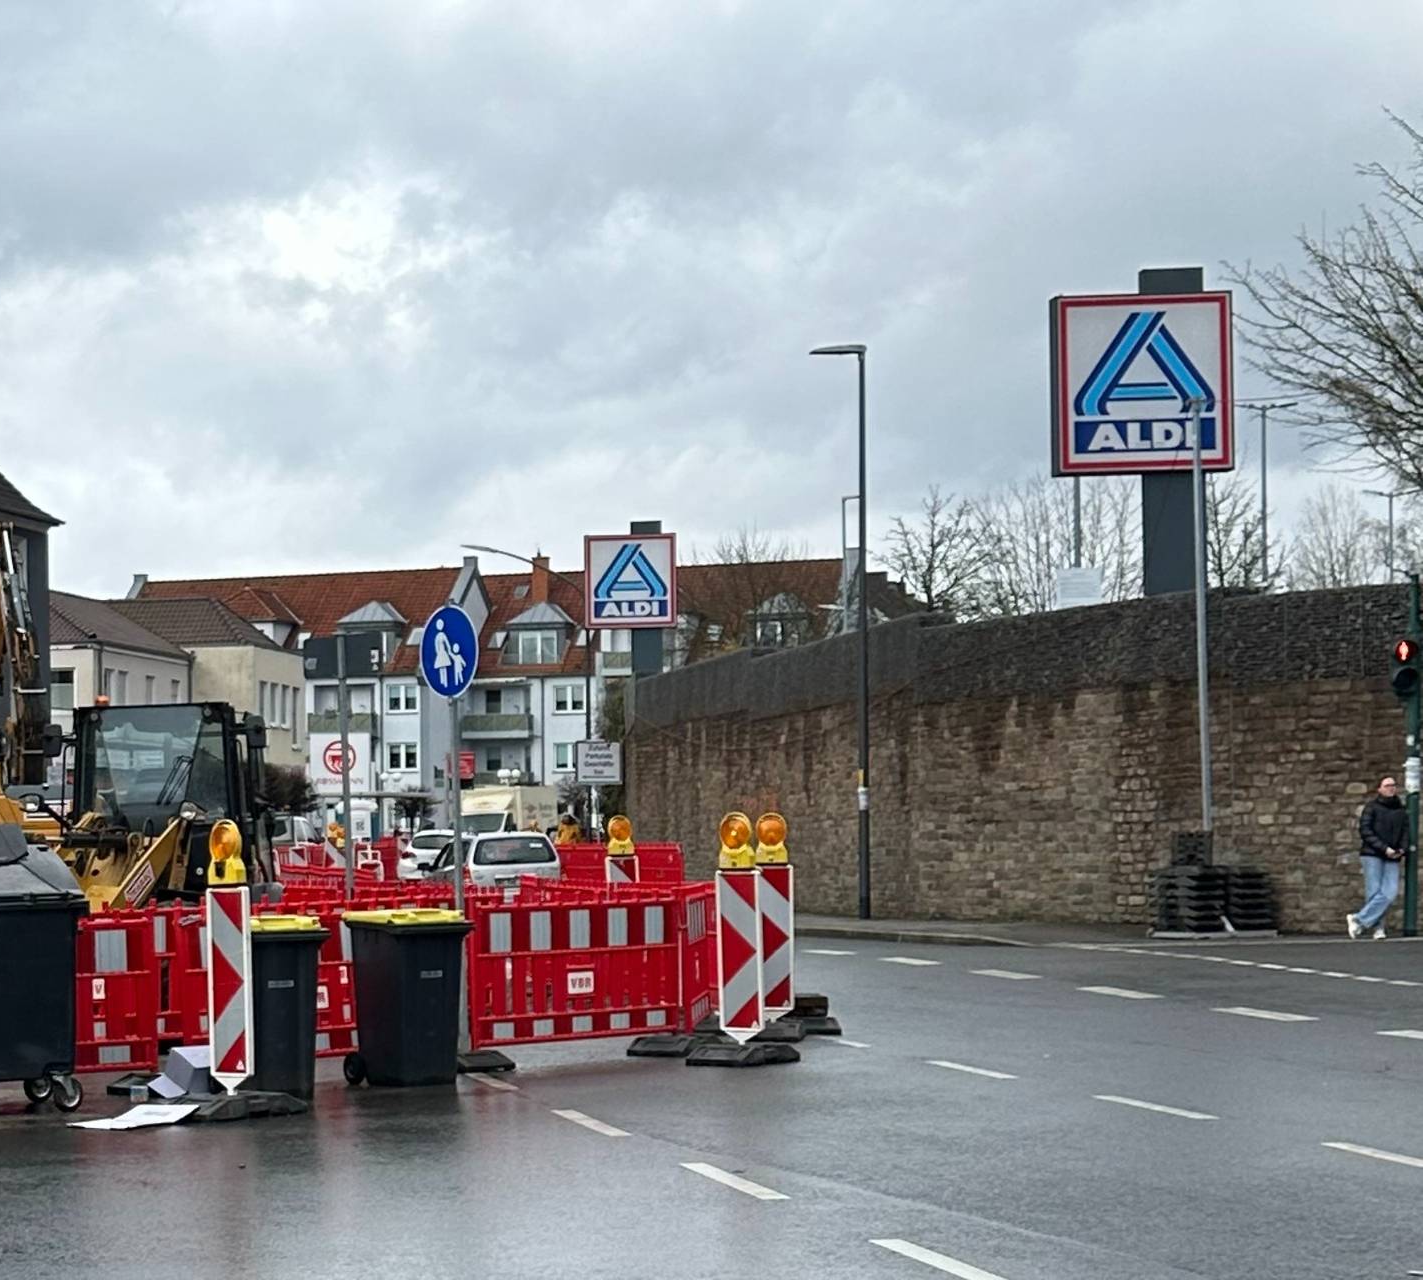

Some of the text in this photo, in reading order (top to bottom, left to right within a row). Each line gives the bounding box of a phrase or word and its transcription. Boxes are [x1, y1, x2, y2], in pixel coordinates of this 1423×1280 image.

[1087, 420, 1195, 451] ALDI
[601, 601, 659, 616] ALDI
[570, 977, 592, 989] VBR
